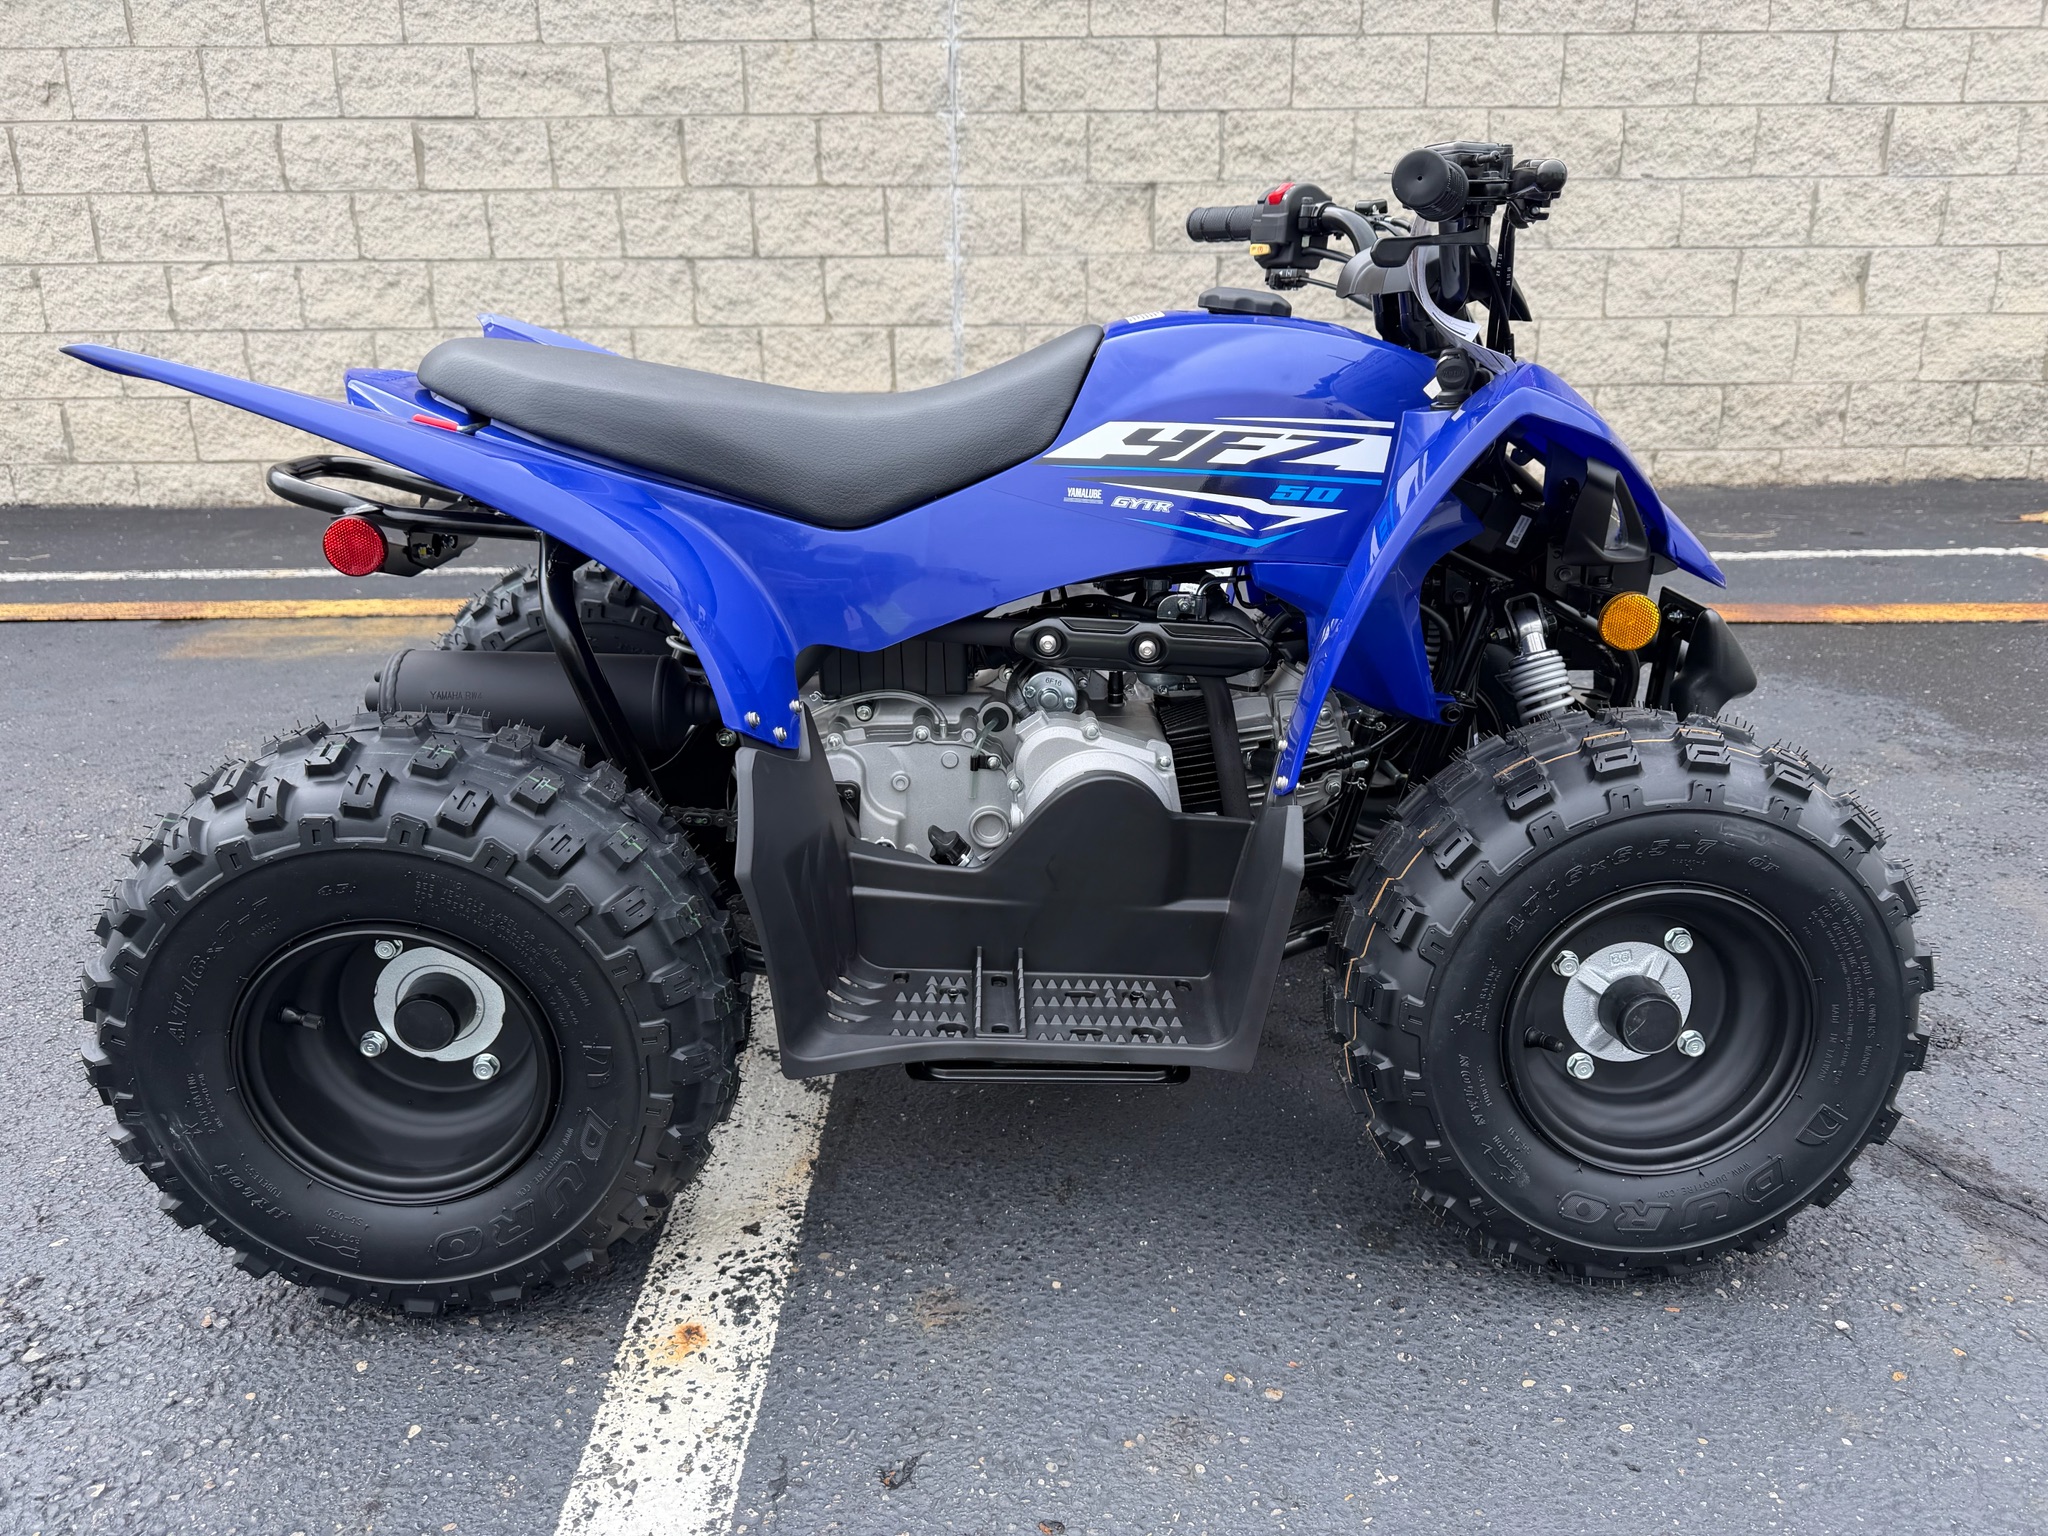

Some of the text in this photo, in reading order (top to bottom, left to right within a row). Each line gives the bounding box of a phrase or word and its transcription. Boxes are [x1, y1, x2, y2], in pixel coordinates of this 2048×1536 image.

[1120, 428, 1365, 466] YFZ
[1066, 487, 1103, 500] YAMALUBE
[1110, 495, 1174, 513] GYTR
[1270, 486, 1344, 503] 50
[430, 691, 463, 700] YAMAHA
[491, 908, 519, 931] LABEL
[243, 1163, 284, 1199] TUBELESS
[434, 1106, 613, 1261] DURO
[1558, 1154, 1785, 1231] DURO
[1657, 1161, 1750, 1199] WWW.DUROTIRE.COM
